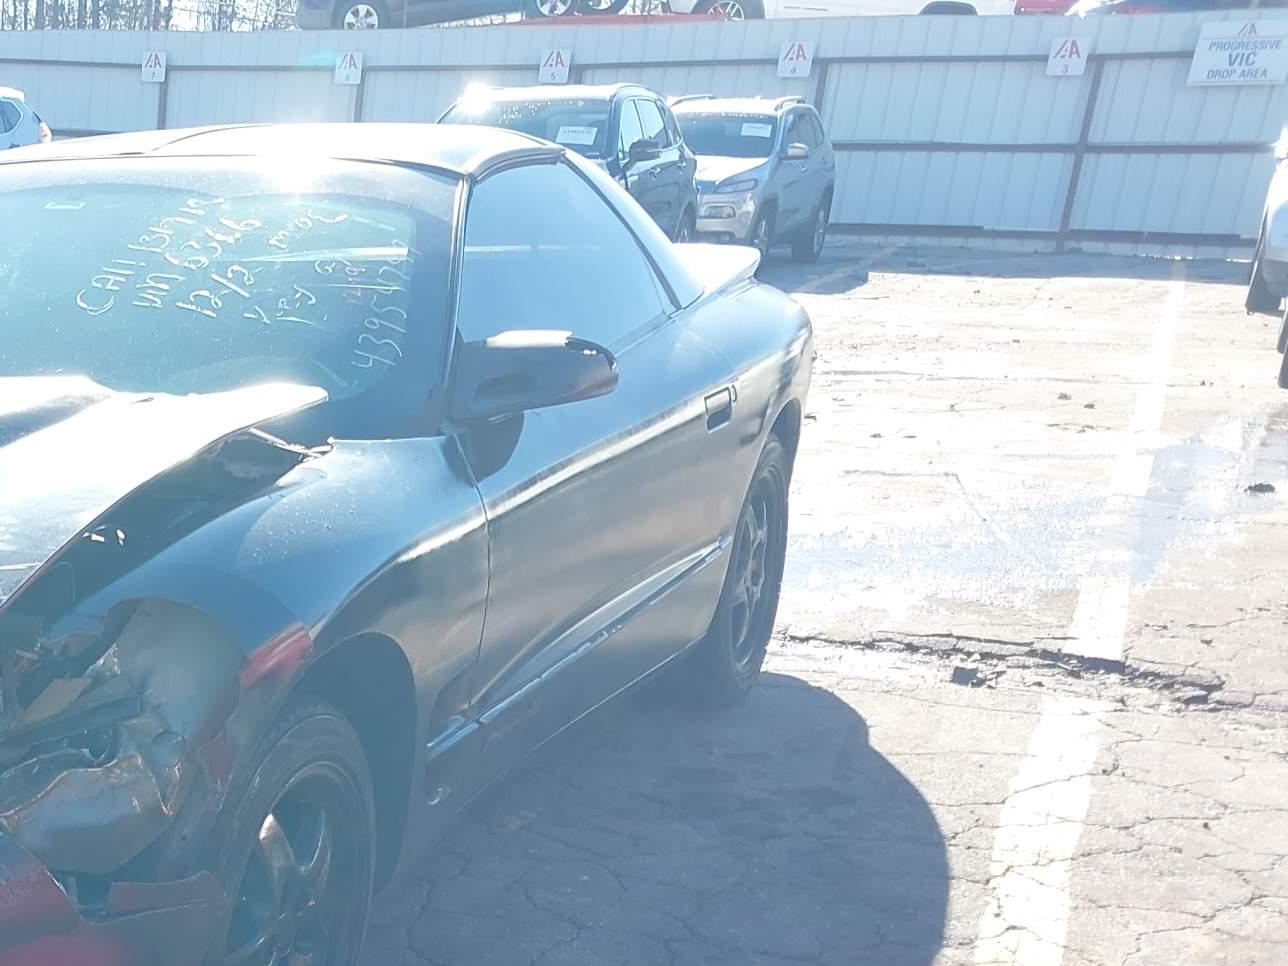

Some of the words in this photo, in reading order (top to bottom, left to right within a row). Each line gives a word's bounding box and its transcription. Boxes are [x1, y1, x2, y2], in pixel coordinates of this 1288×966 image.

[1208, 39, 1281, 52] PROGRESSIVE
[1228, 52, 1257, 67] VIC
[1206, 68, 1236, 80] DROP
[1238, 68, 1268, 79] AREA
